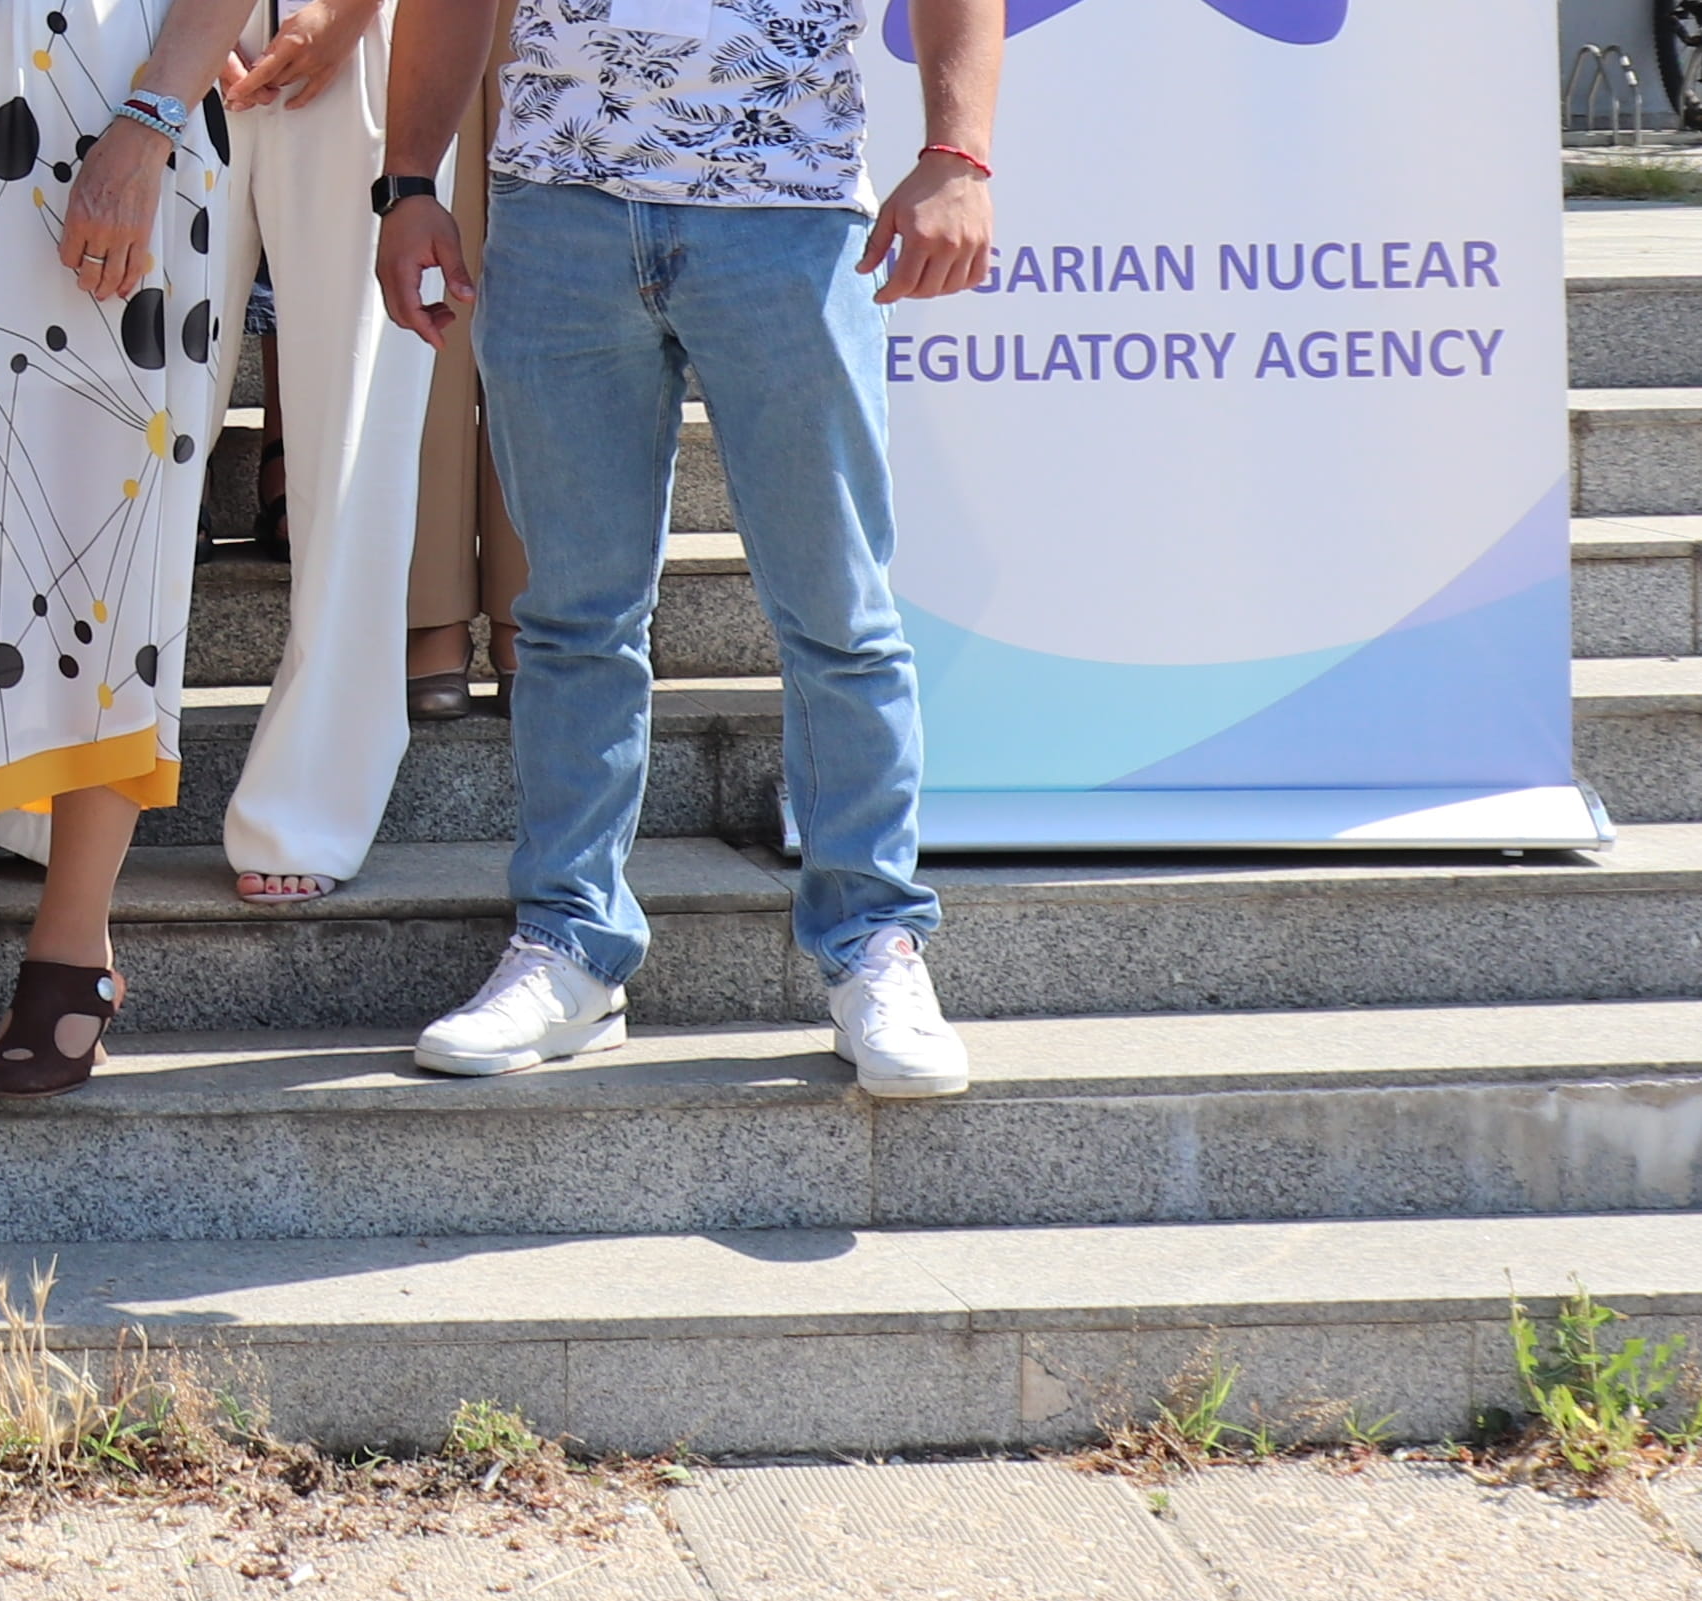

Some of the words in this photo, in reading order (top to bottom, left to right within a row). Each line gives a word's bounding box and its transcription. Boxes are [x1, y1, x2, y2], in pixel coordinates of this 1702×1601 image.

[886, 243, 1195, 294] GARIAN
[1218, 240, 1500, 291] NUCLEAR
[886, 331, 1237, 383] EGULATORY
[1254, 328, 1505, 380] AGENCY
